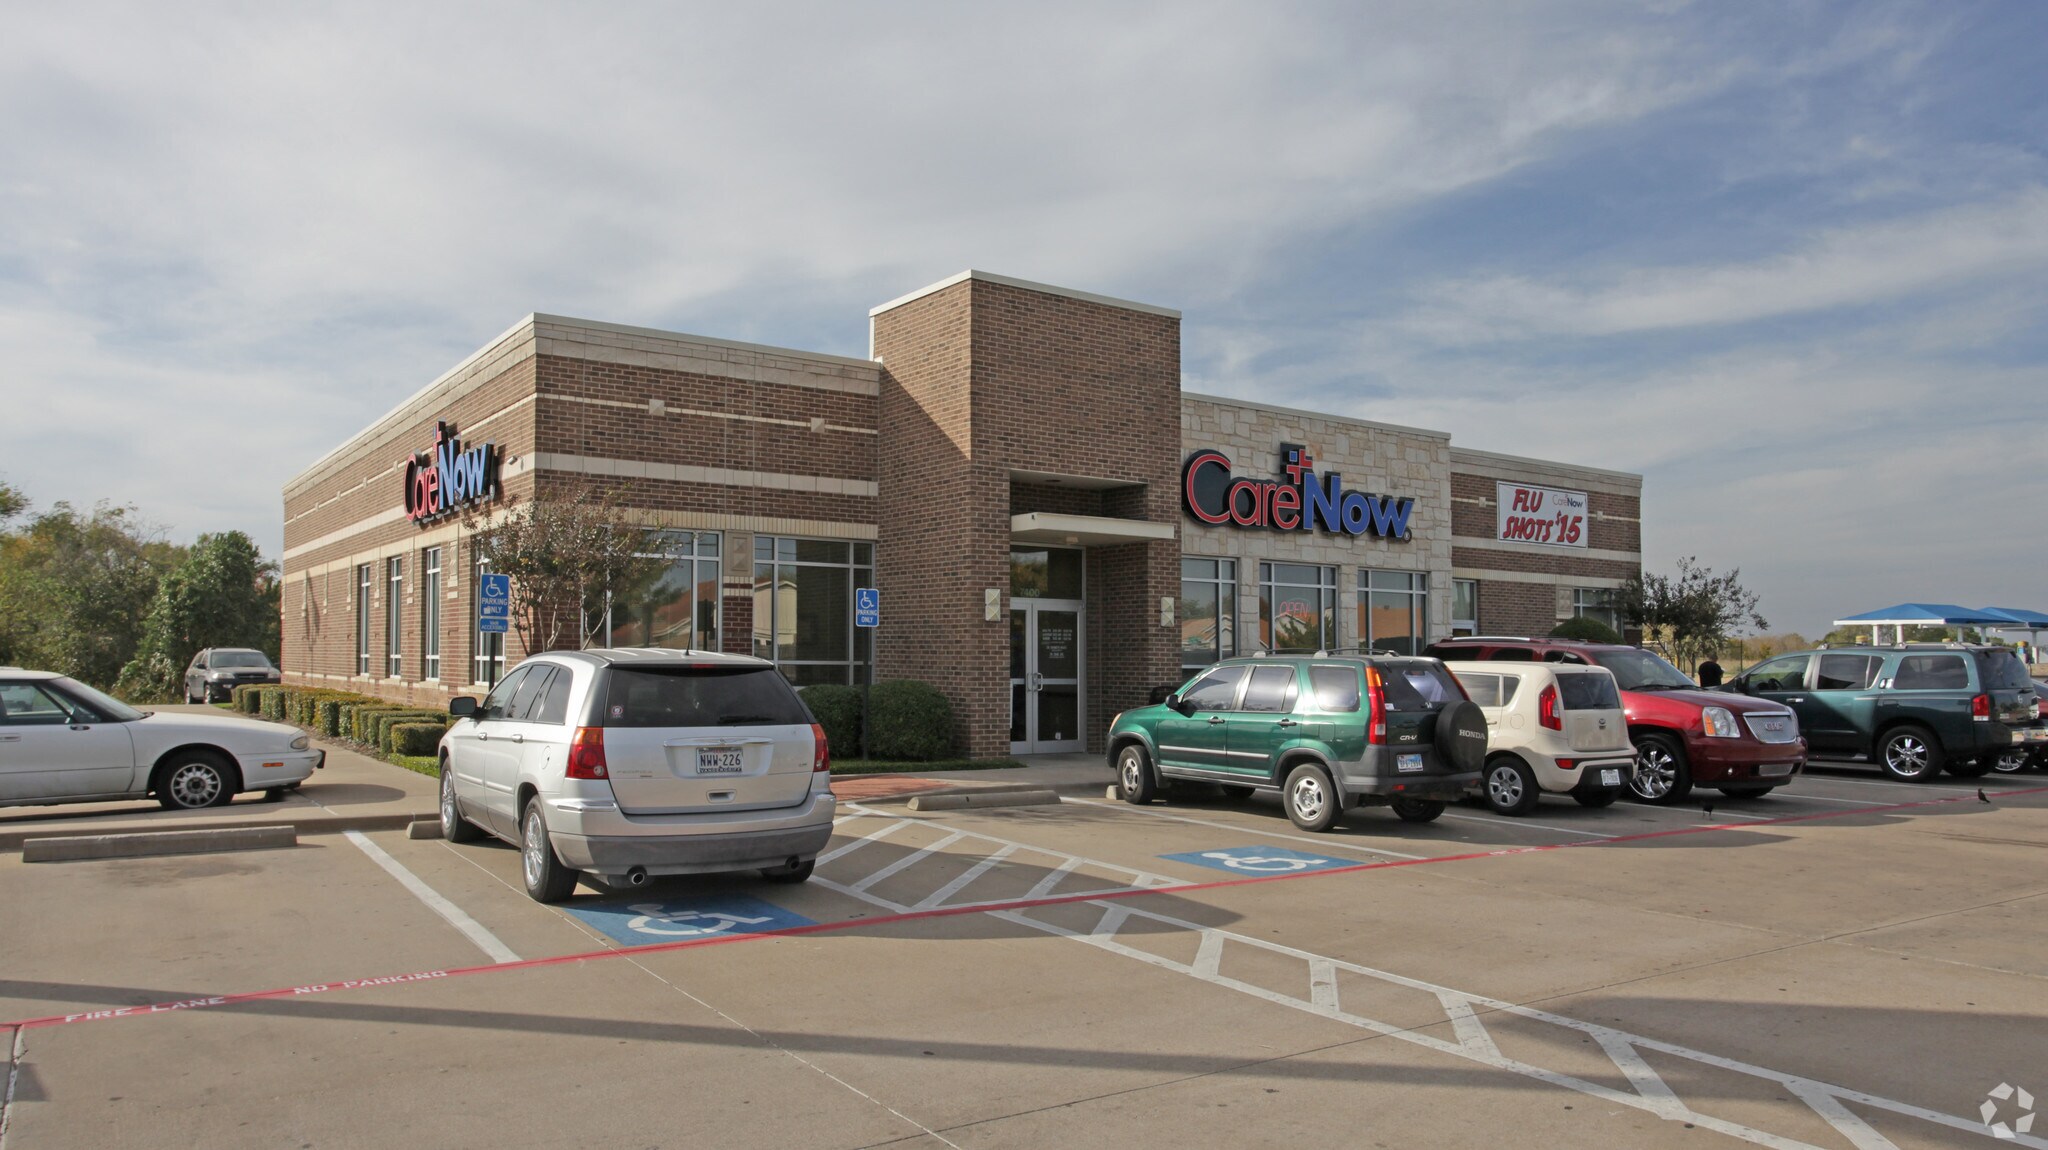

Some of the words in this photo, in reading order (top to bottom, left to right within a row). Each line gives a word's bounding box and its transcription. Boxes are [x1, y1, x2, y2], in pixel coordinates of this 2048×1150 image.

[404, 438, 488, 521] CareNow
[1186, 453, 1415, 538] CareNow
[1512, 488, 1543, 513] FLU
[1552, 494, 1583, 508] CareNow
[1503, 515, 1553, 542] SHOTS
[1555, 510, 1583, 543] $15
[481, 597, 508, 606] PARKING
[484, 606, 503, 614] NLY
[1280, 601, 1309, 618] OPEN
[1459, 729, 1486, 740] HONDA
[294, 985, 328, 995] NO
[343, 970, 448, 989] PARKING
[65, 1007, 132, 1023] FIRE
[151, 996, 225, 1012] LANE
